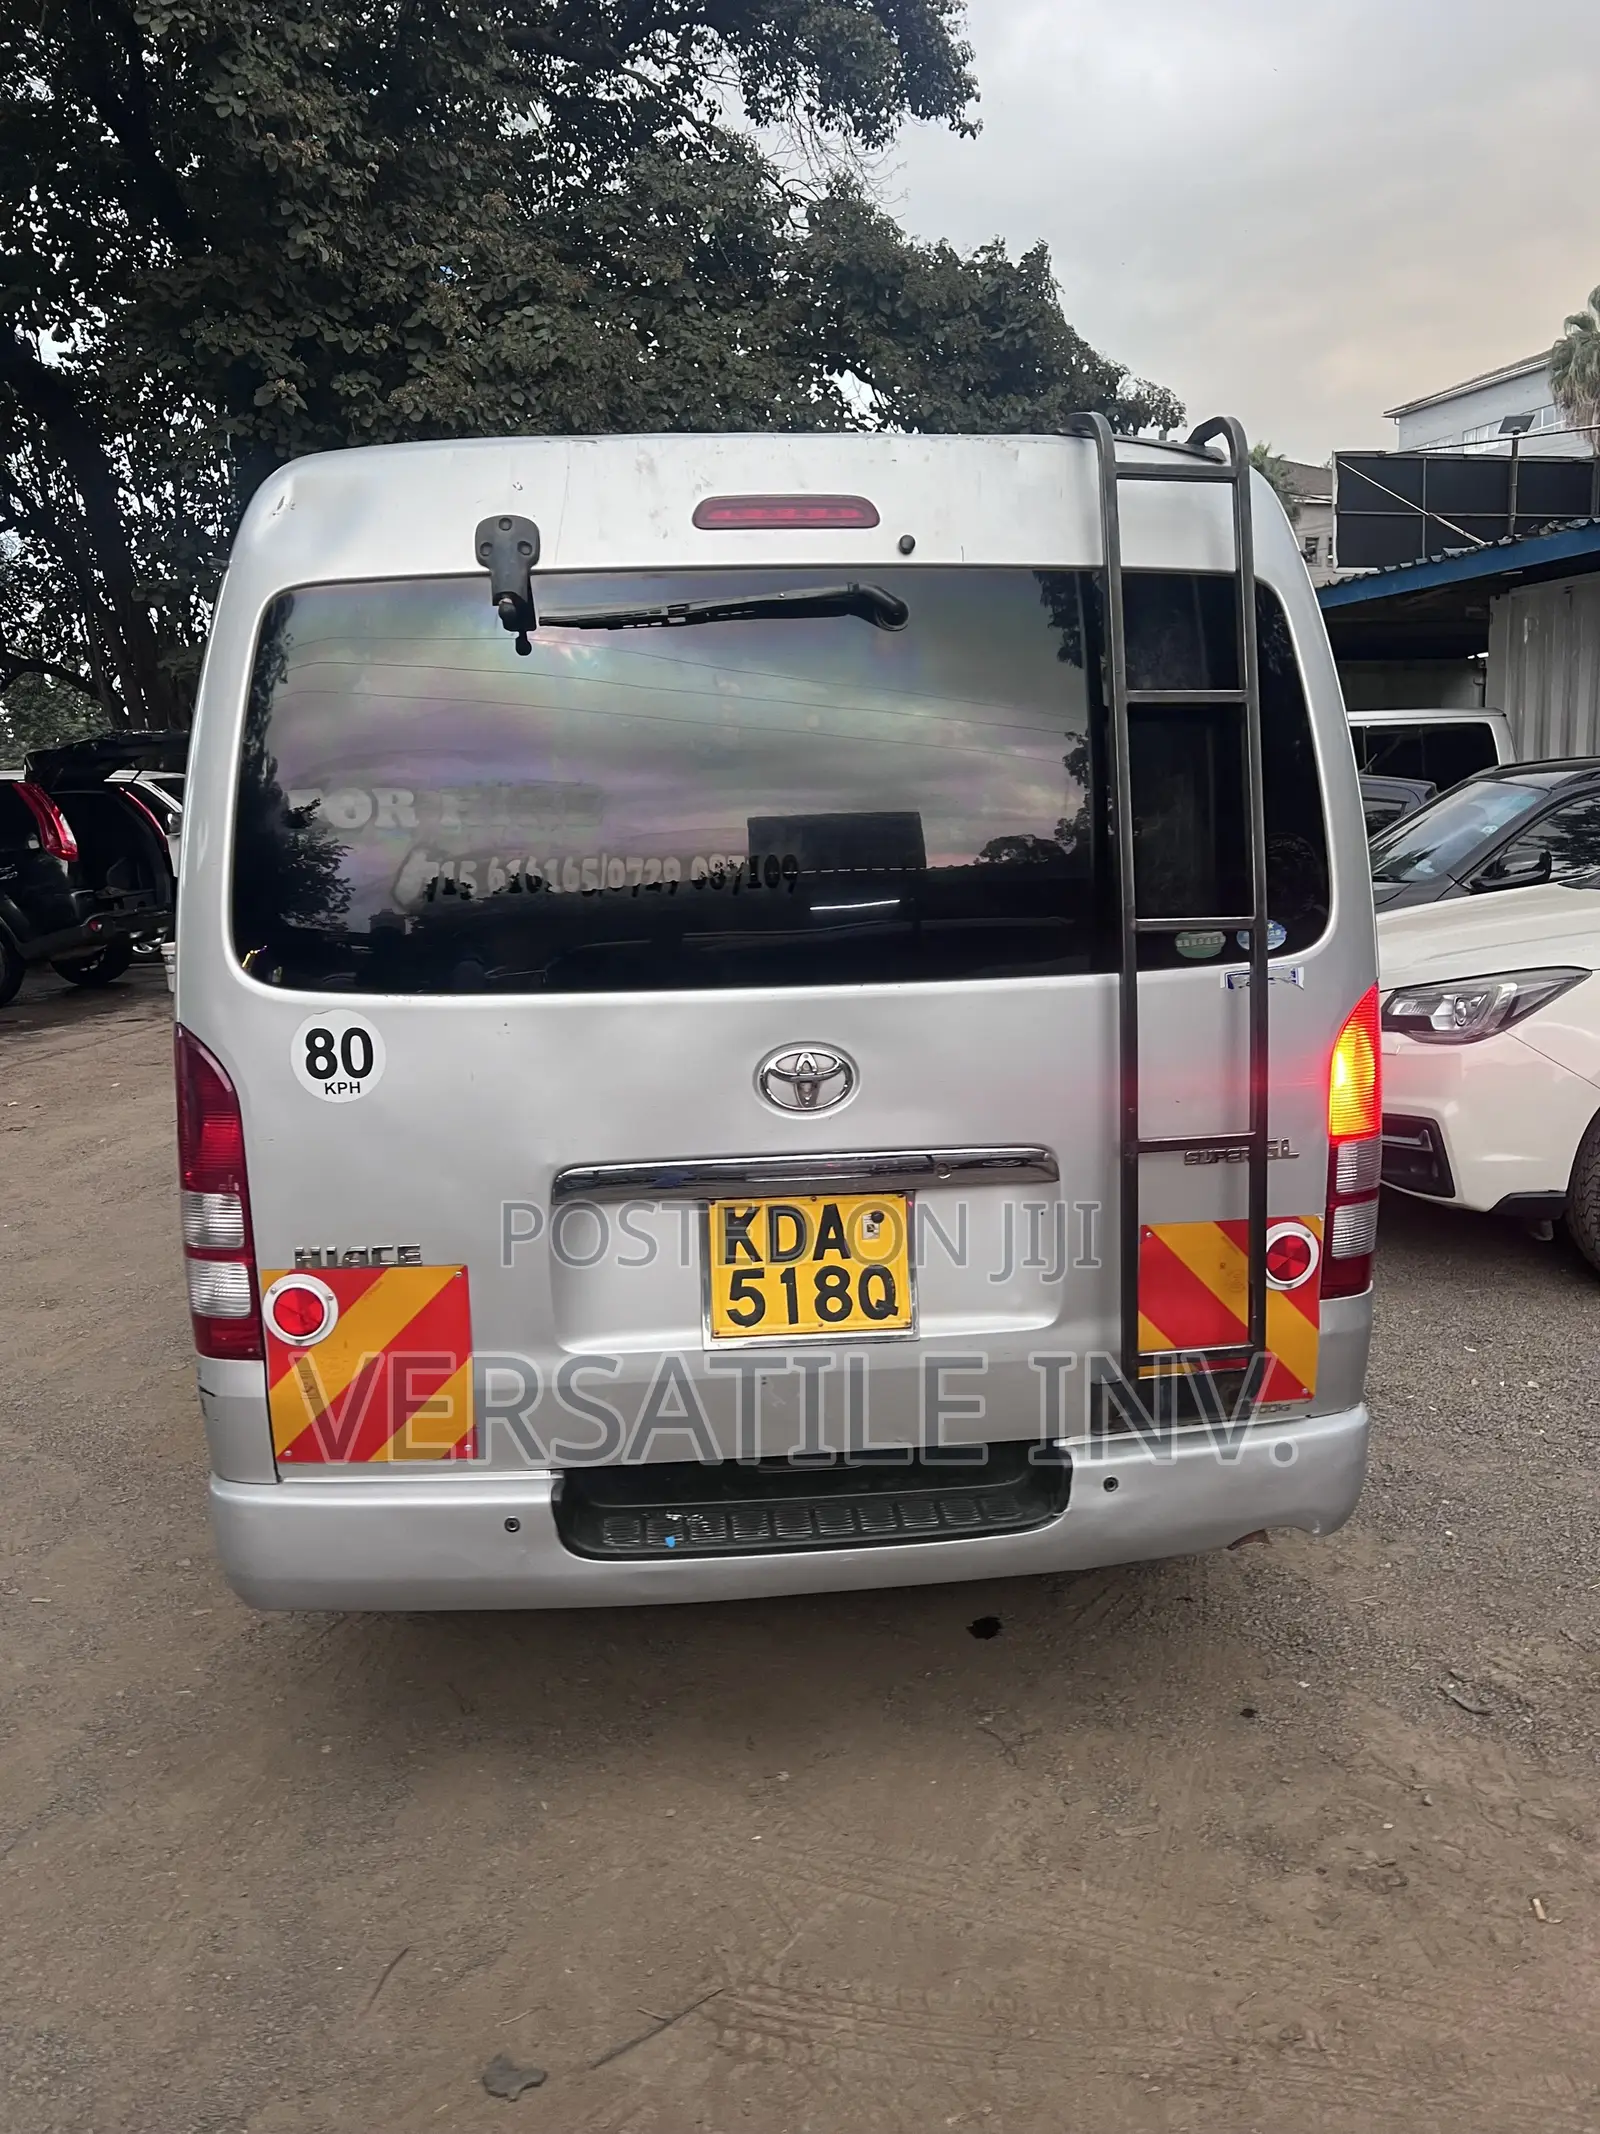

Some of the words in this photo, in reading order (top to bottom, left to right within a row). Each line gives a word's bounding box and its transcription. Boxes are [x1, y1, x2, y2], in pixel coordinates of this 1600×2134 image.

[305, 1027, 374, 1080] 80
[324, 1081, 361, 1095] KPH
[294, 1244, 424, 1269] HIACE
[723, 1203, 852, 1266] KDA
[725, 1264, 898, 1328] 518Q
